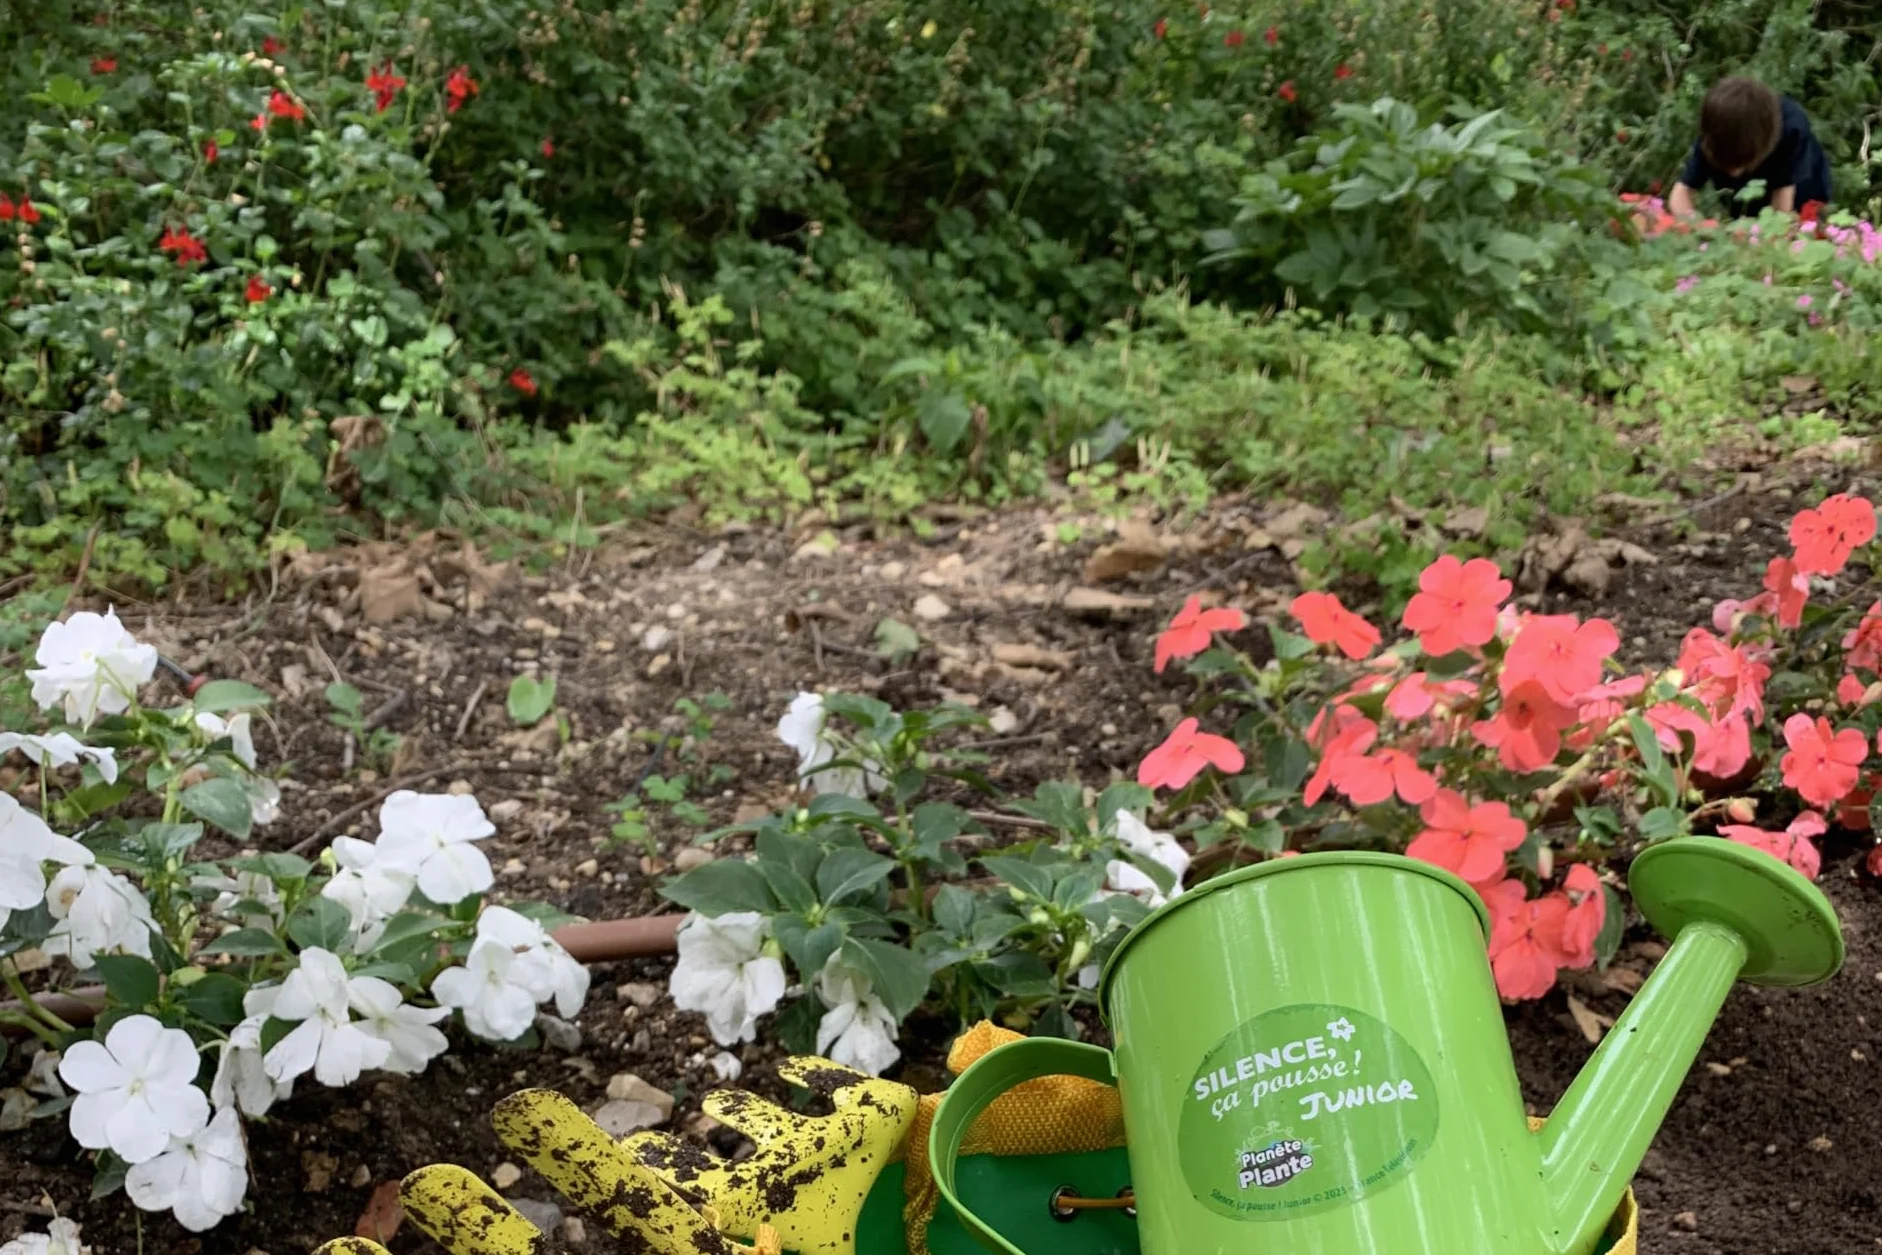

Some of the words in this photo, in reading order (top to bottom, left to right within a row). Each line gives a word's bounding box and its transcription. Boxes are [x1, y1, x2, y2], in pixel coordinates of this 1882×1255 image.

[1194, 1036, 1337, 1100] SILENCE,
[1211, 1090, 1241, 1122] ça
[1299, 1079, 1418, 1120] JUNIOR
[1242, 1140, 1302, 1167] Planète
[1239, 1155, 1313, 1189] Plante
[1324, 1186, 1347, 1200] 2023
